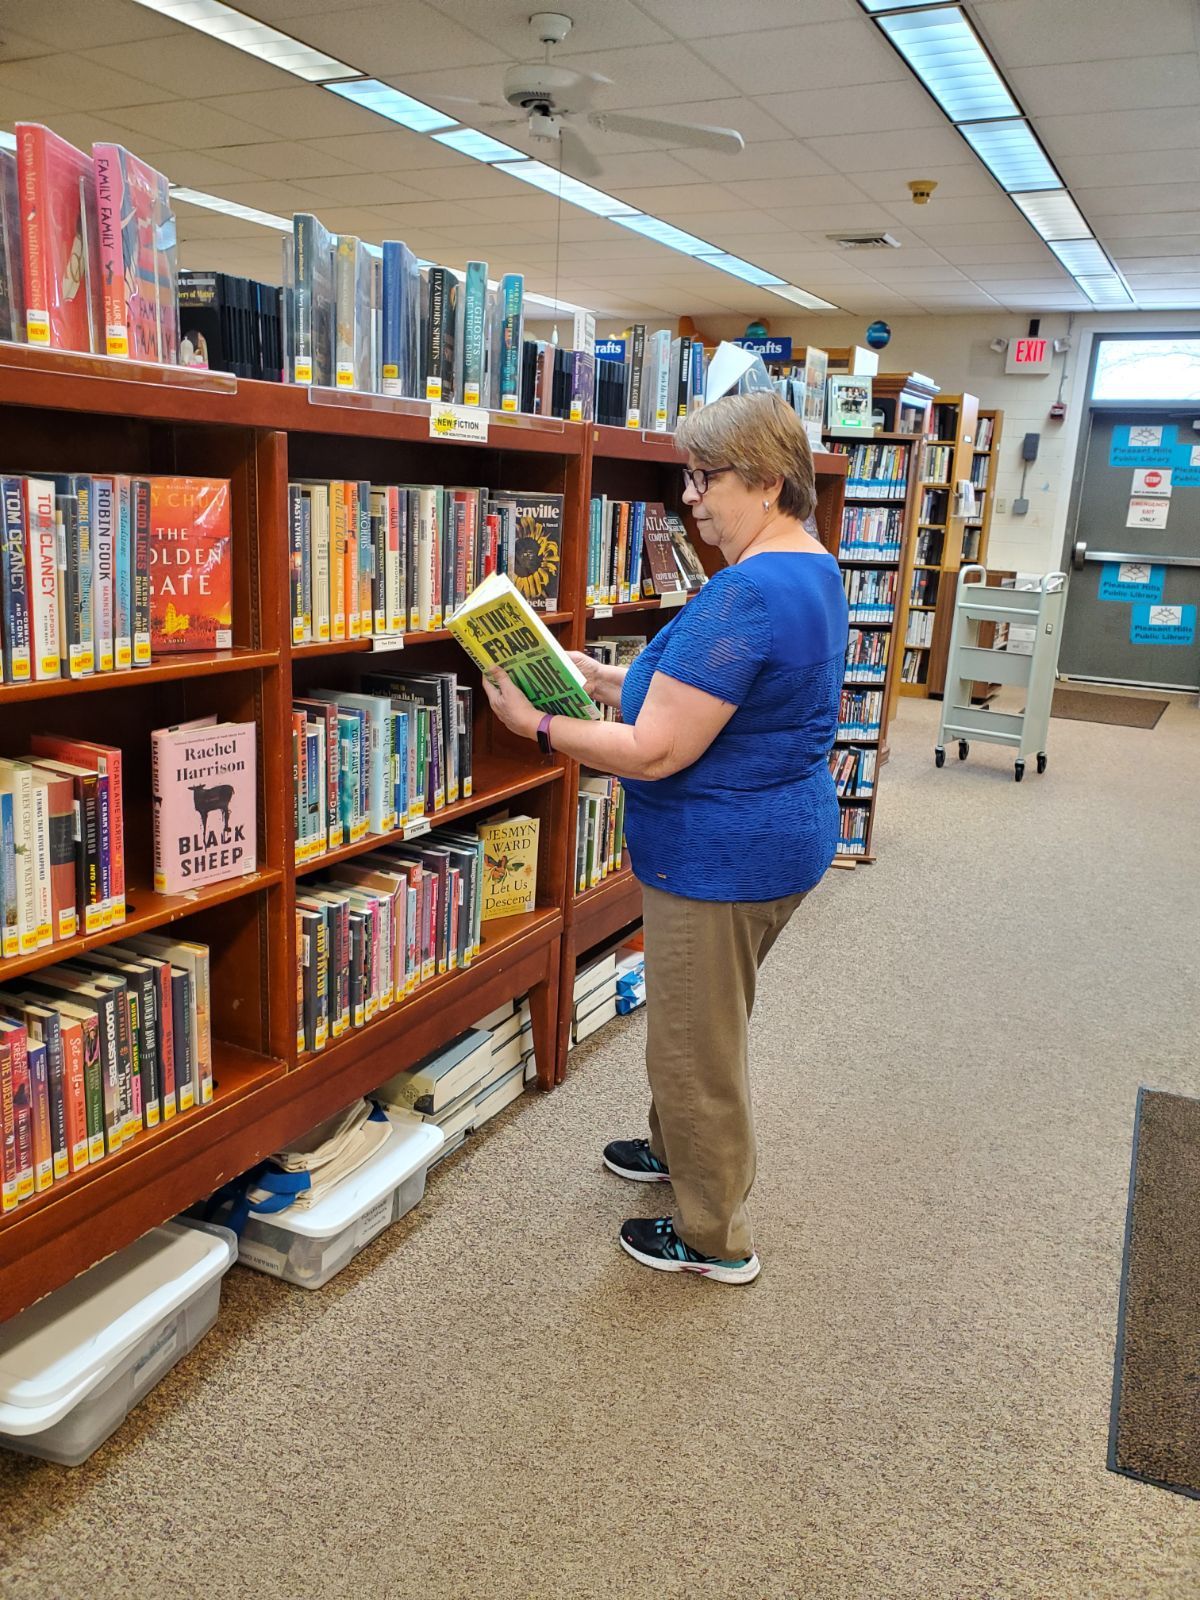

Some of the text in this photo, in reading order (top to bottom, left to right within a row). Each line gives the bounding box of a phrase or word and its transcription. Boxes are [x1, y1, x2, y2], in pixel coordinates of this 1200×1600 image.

[25, 170, 36, 205] Mary
[97, 158, 115, 250] FAMILY FAMILY
[28, 223, 41, 279] Kathleen
[432, 271, 443, 361] HAZARDOUS SPIRITS
[465, 295, 474, 367] BEATRICE BIRD
[473, 306, 482, 356] GHOSTS
[595, 341, 622, 354] rafts
[1015, 340, 1047, 362] EXIT
[437, 417, 480, 430] NEW FICTION
[120, 487, 129, 504] The
[77, 489, 91, 565] MICHAEL CONNELLY
[136, 488, 148, 571] BLOOD LINES
[293, 498, 303, 549] PAST LYING
[334, 488, 346, 554] ONE BLOOD
[360, 510, 370, 550] MORRIS
[390, 507, 398, 529] JULIA
[646, 516, 669, 531] ATLAS
[5, 488, 25, 595] TOM CLANCY
[37, 494, 56, 599] TOM CLANCY
[98, 488, 112, 581] ROBIN COOK
[156, 527, 189, 541] THE
[150, 548, 223, 565] OLDEN
[456, 521, 466, 593] JAMES PATTERSON
[141, 576, 149, 607] NELSON
[149, 575, 212, 595] ATE
[1103, 581, 1161, 592] Pleasant Hills
[1103, 589, 1158, 600] Public Library
[102, 585, 110, 618] MANNER
[476, 605, 514, 636] THE
[138, 647, 149, 655] NEW
[482, 626, 540, 664] FRAUD
[1162, 633, 1191, 641] Library
[45, 661, 58, 669] NEW
[185, 740, 237, 761] Rachel
[351, 727, 360, 775] YOUR FAULT
[176, 761, 245, 781] Harrison
[112, 759, 122, 817] CHARLAINE
[21, 776, 32, 841] LAUREN GROFF
[101, 801, 109, 834] CHARM'S
[329, 799, 337, 826] DEAT
[178, 825, 246, 855] BLACK
[486, 823, 537, 841] JESMYN
[493, 838, 531, 853] WARD
[38, 854, 46, 881] HAPPENED
[180, 847, 244, 877] SHEEP
[24, 867, 33, 898] VASTER
[491, 880, 528, 895] Let Us
[25, 900, 34, 924] WILD
[114, 907, 125, 915] NEW
[485, 891, 532, 910] Descend
[37, 928, 50, 937] NEW
[62, 922, 74, 930] NEW
[89, 917, 101, 925] NEW
[25, 935, 37, 944] NEW
[316, 922, 326, 998] BRAD TAYLOR
[13, 1041, 21, 1075] KRENTZ
[105, 1000, 118, 1087] BLOOD SISTERS
[69, 1037, 83, 1097] Set on You
[1, 1056, 14, 1134] THE LIBERATORS
[77, 1101, 85, 1123] AMY
[18, 1108, 30, 1150] THE NIGHT
